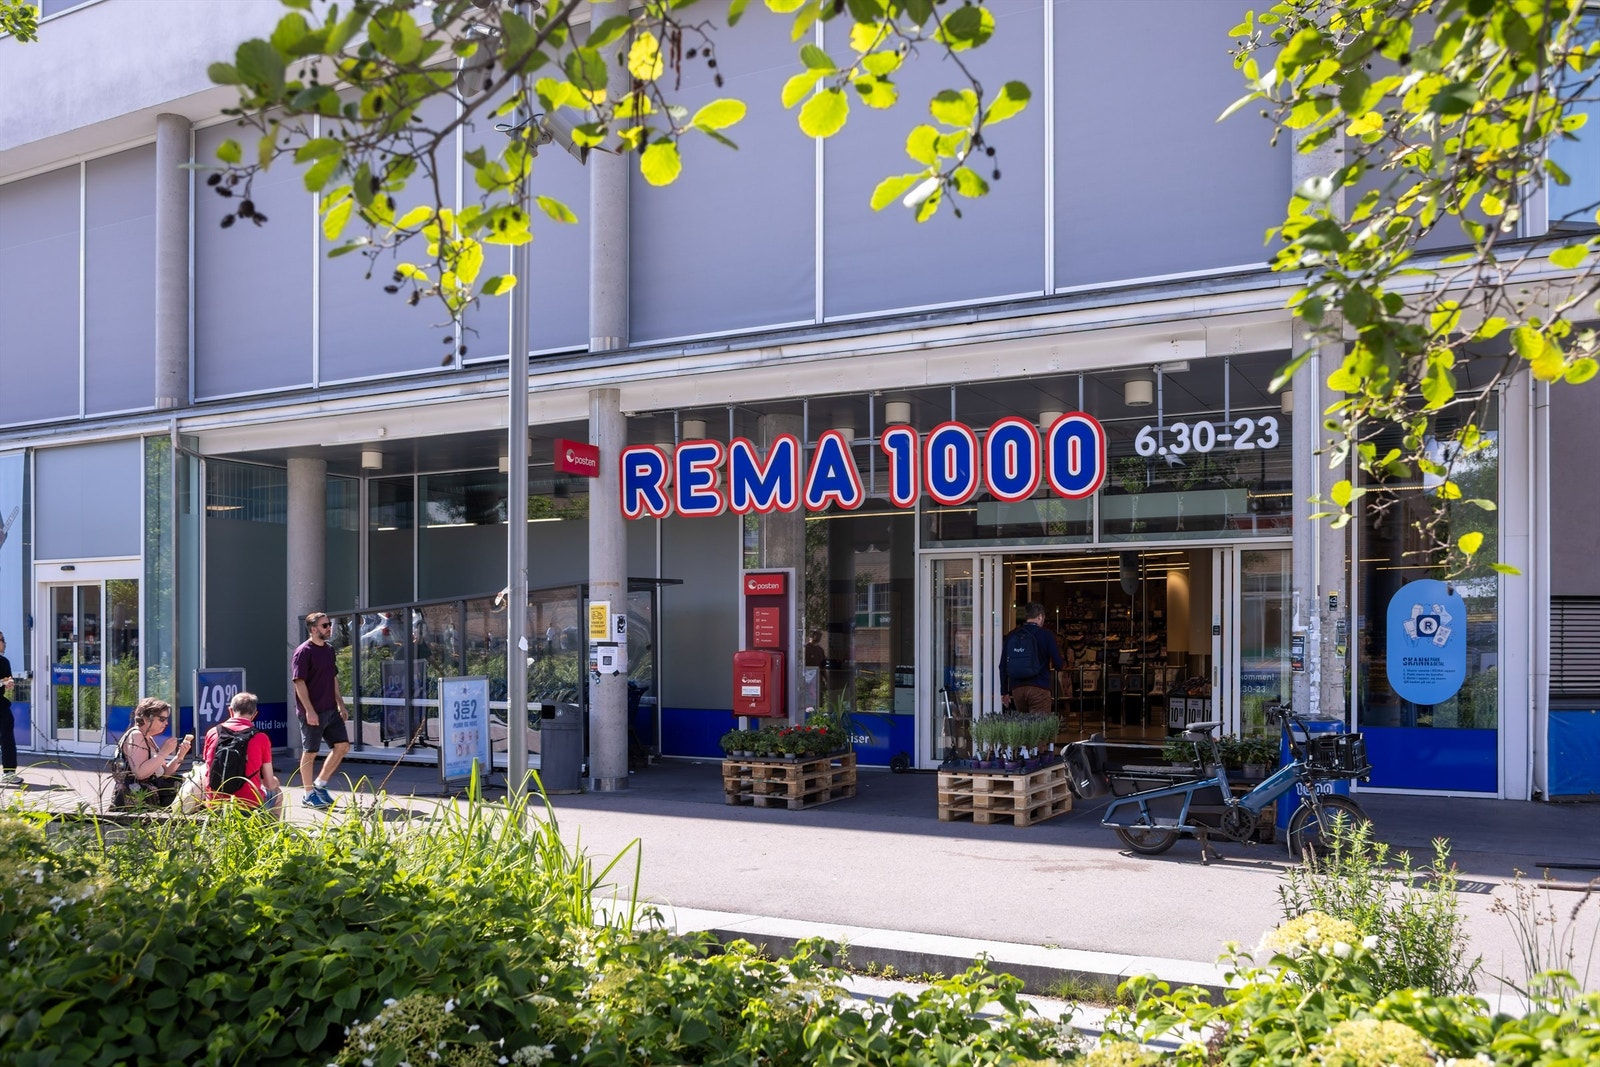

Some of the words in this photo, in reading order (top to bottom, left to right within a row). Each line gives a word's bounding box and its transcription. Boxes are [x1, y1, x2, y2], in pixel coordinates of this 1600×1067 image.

[1135, 416, 1280, 457] 6.30-23
[574, 457, 595, 467] posten
[620, 429, 864, 520] REMA
[884, 411, 1107, 508] 1000
[1425, 622, 1432, 630] R
[1403, 657, 1430, 666] SKANN
[199, 684, 225, 723] 49
[453, 700, 460, 721] 3
[461, 699, 470, 720] FOR
[470, 698, 478, 719] 2
[847, 733, 870, 744] iser
